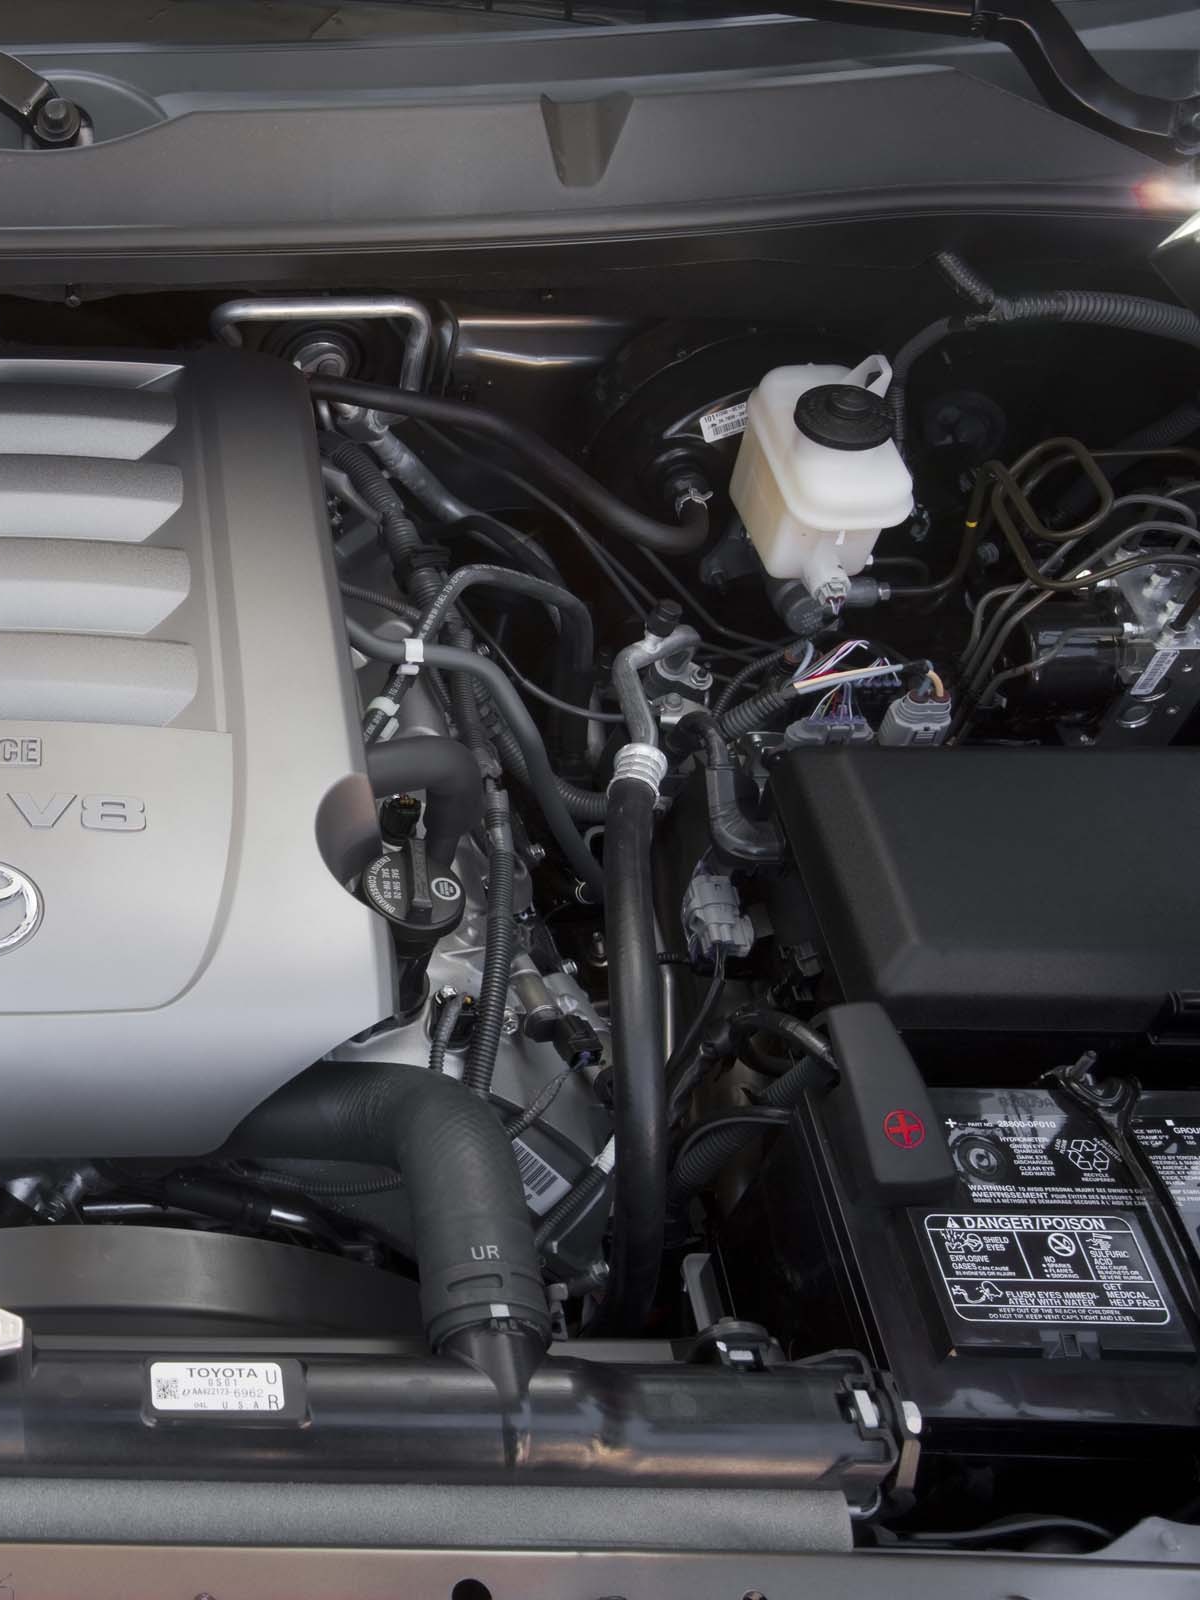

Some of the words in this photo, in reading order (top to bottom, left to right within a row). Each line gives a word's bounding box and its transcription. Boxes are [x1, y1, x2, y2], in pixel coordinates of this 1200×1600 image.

[5, 793, 147, 832] V8
[381, 867, 390, 879] SAE
[391, 868, 400, 880] SAE
[471, 1244, 500, 1260] UR
[950, 1254, 990, 1262] EXPLOSIVE
[1090, 1250, 1130, 1258] SULFURIC
[1006, 1290, 1036, 1298] FLUSH
[1038, 1291, 1062, 1299] EYES
[1064, 1292, 1100, 1300] IMMEDI-
[1106, 1291, 1150, 1299] MEDICAL
[186, 1367, 258, 1379] TOYOTA
[265, 1369, 278, 1385] U
[268, 1394, 279, 1410] R
